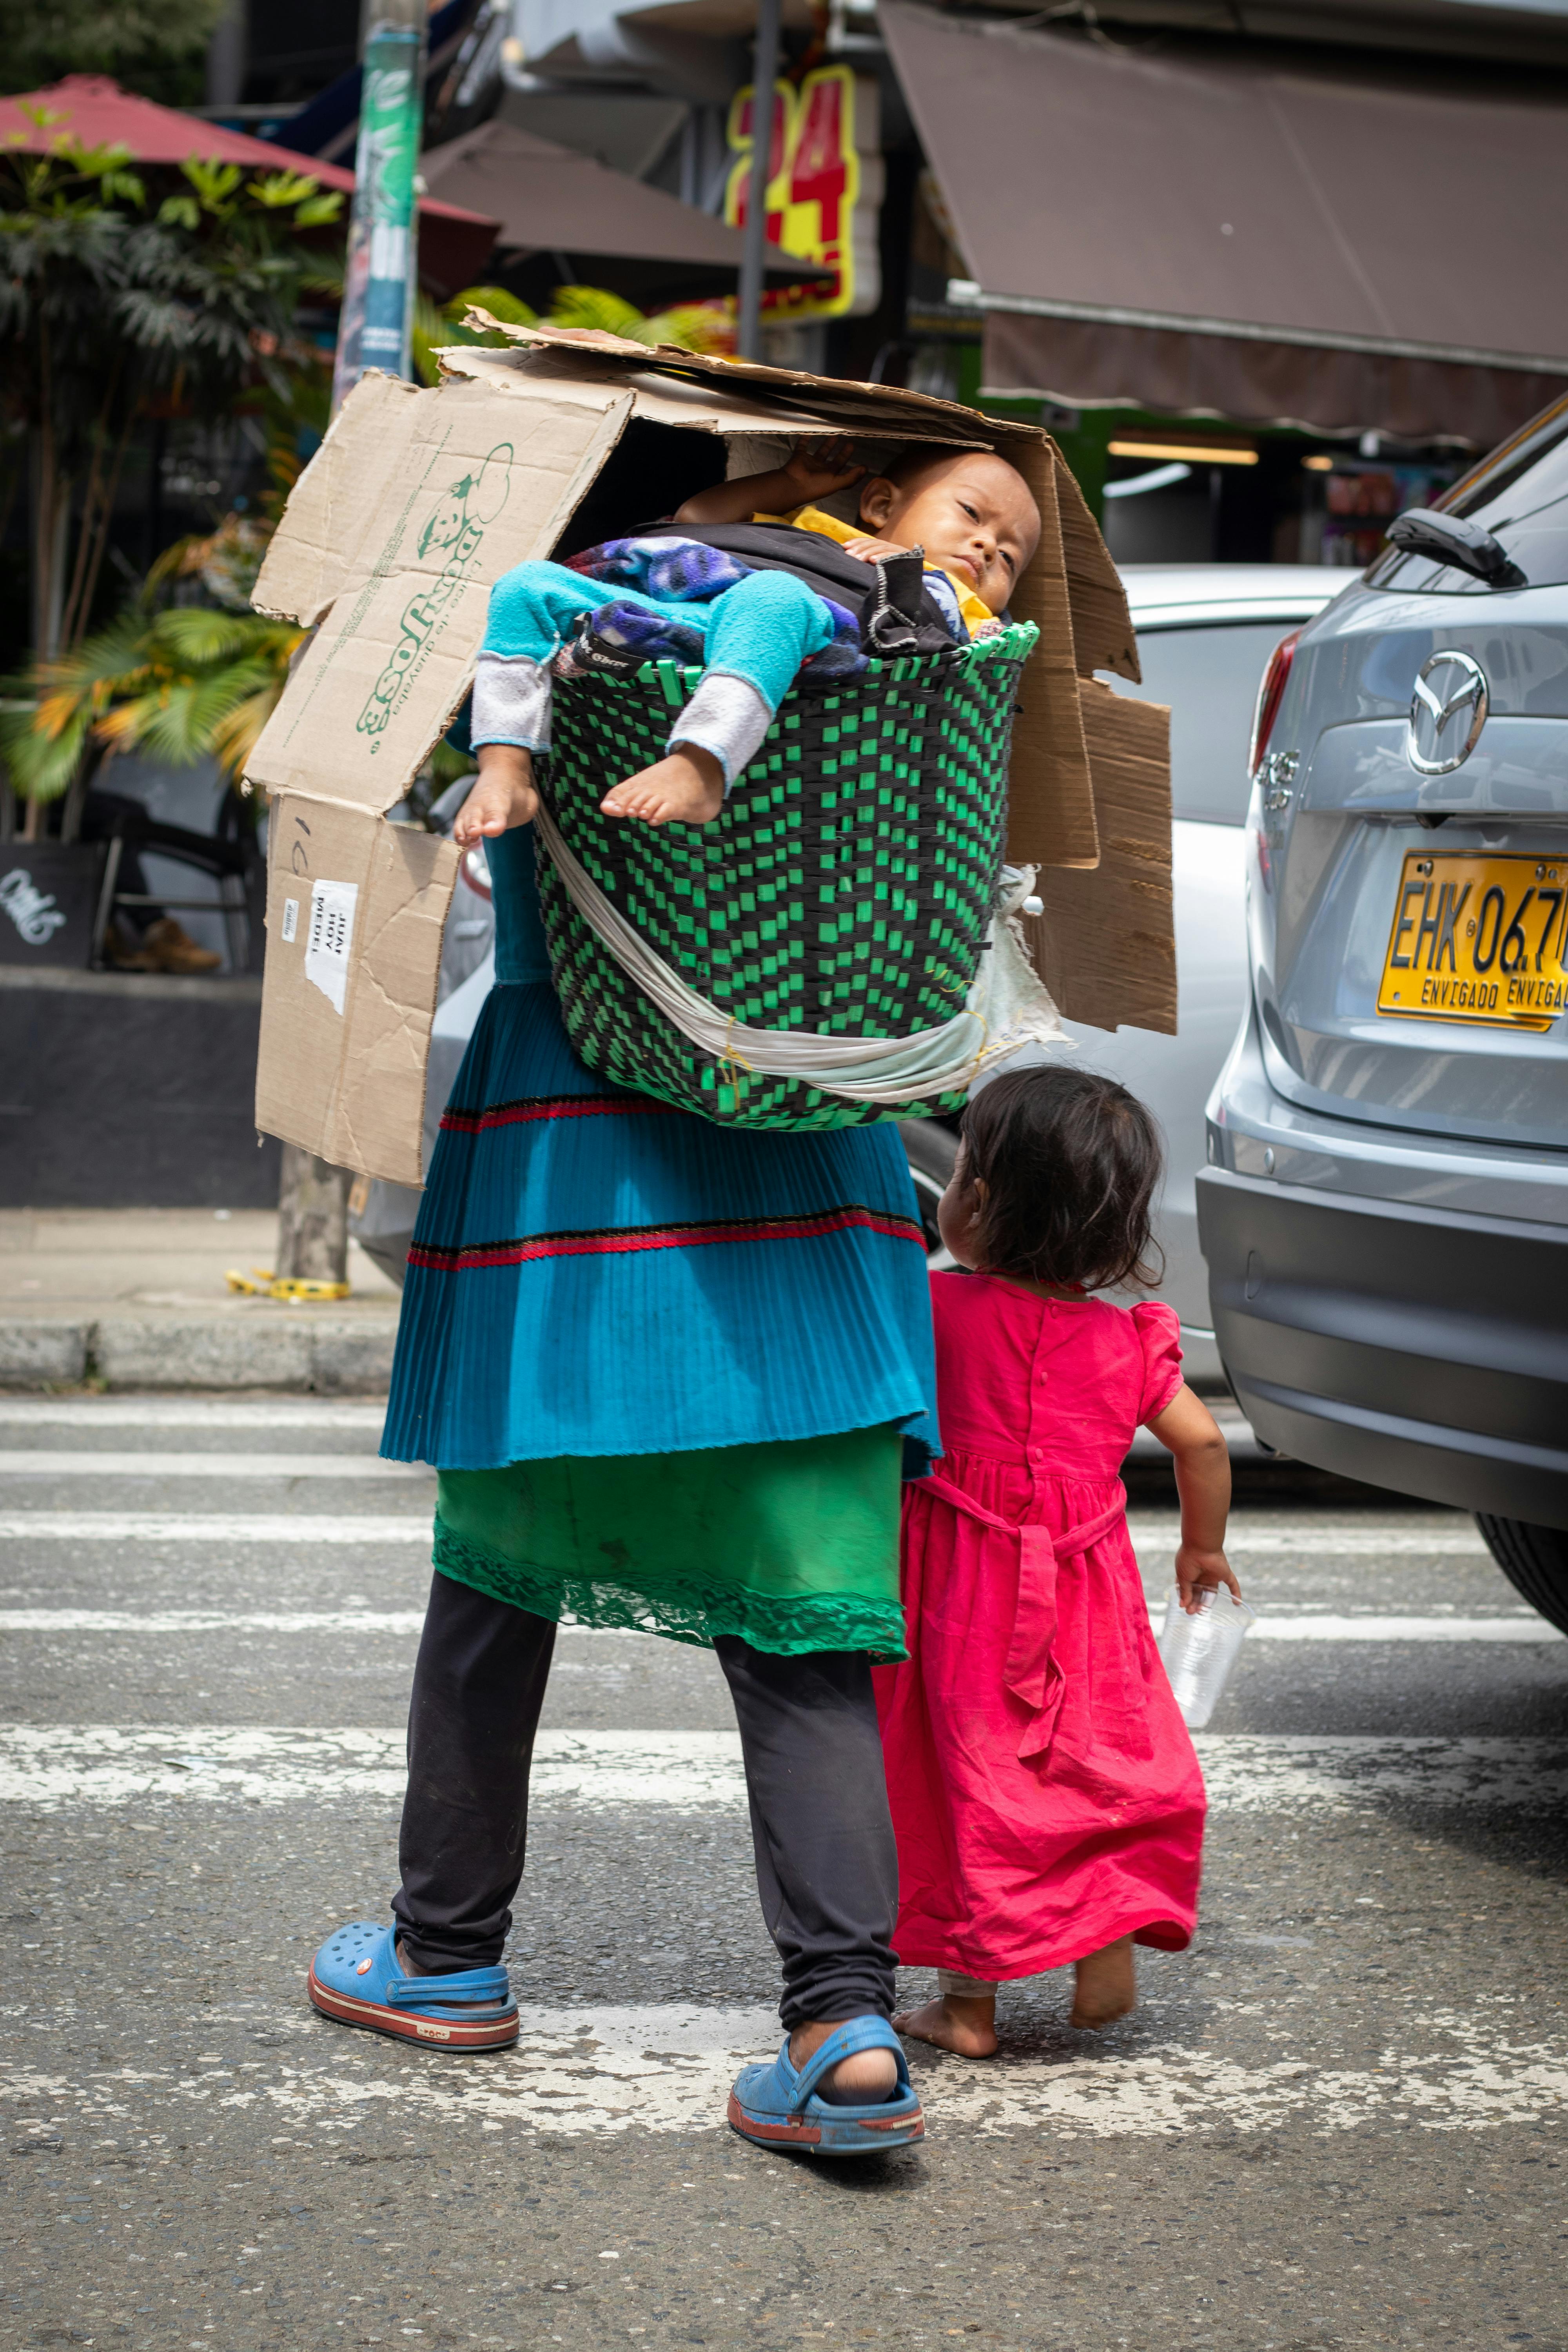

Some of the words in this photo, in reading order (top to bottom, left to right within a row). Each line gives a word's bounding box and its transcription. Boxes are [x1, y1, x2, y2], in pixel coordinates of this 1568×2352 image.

[432, 525, 483, 615] DON
[356, 593, 434, 736] JOSÉ
[436, 614, 450, 635] de
[392, 640, 435, 716] guayaba
[1390, 881, 1472, 972] EHK
[1472, 884, 1564, 974] 067
[1421, 977, 1500, 1009] ENVIGADO
